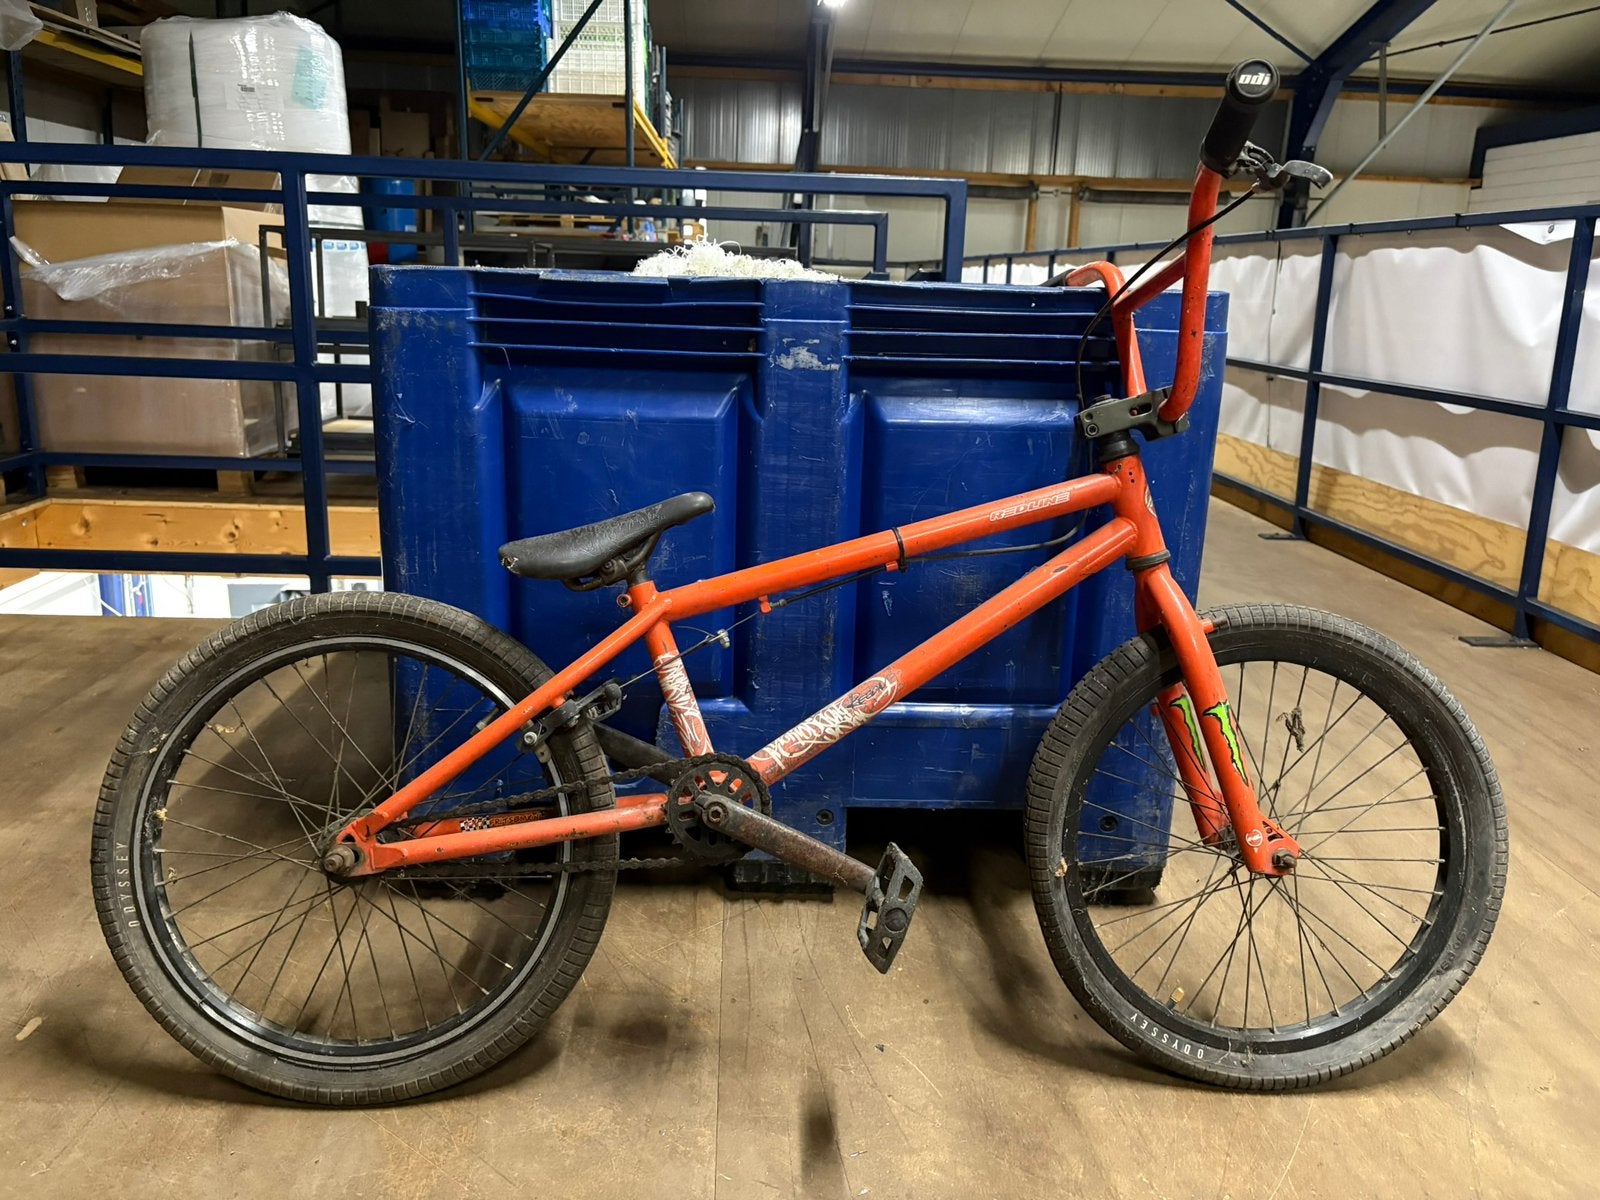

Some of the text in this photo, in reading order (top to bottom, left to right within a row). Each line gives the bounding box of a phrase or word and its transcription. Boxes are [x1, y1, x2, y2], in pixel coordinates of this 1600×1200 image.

[1238, 73, 1271, 86] odi
[989, 490, 1071, 522] REDLINE
[116, 842, 141, 928] ODYSSEY
[1130, 1012, 1205, 1060] ODYSSEY
